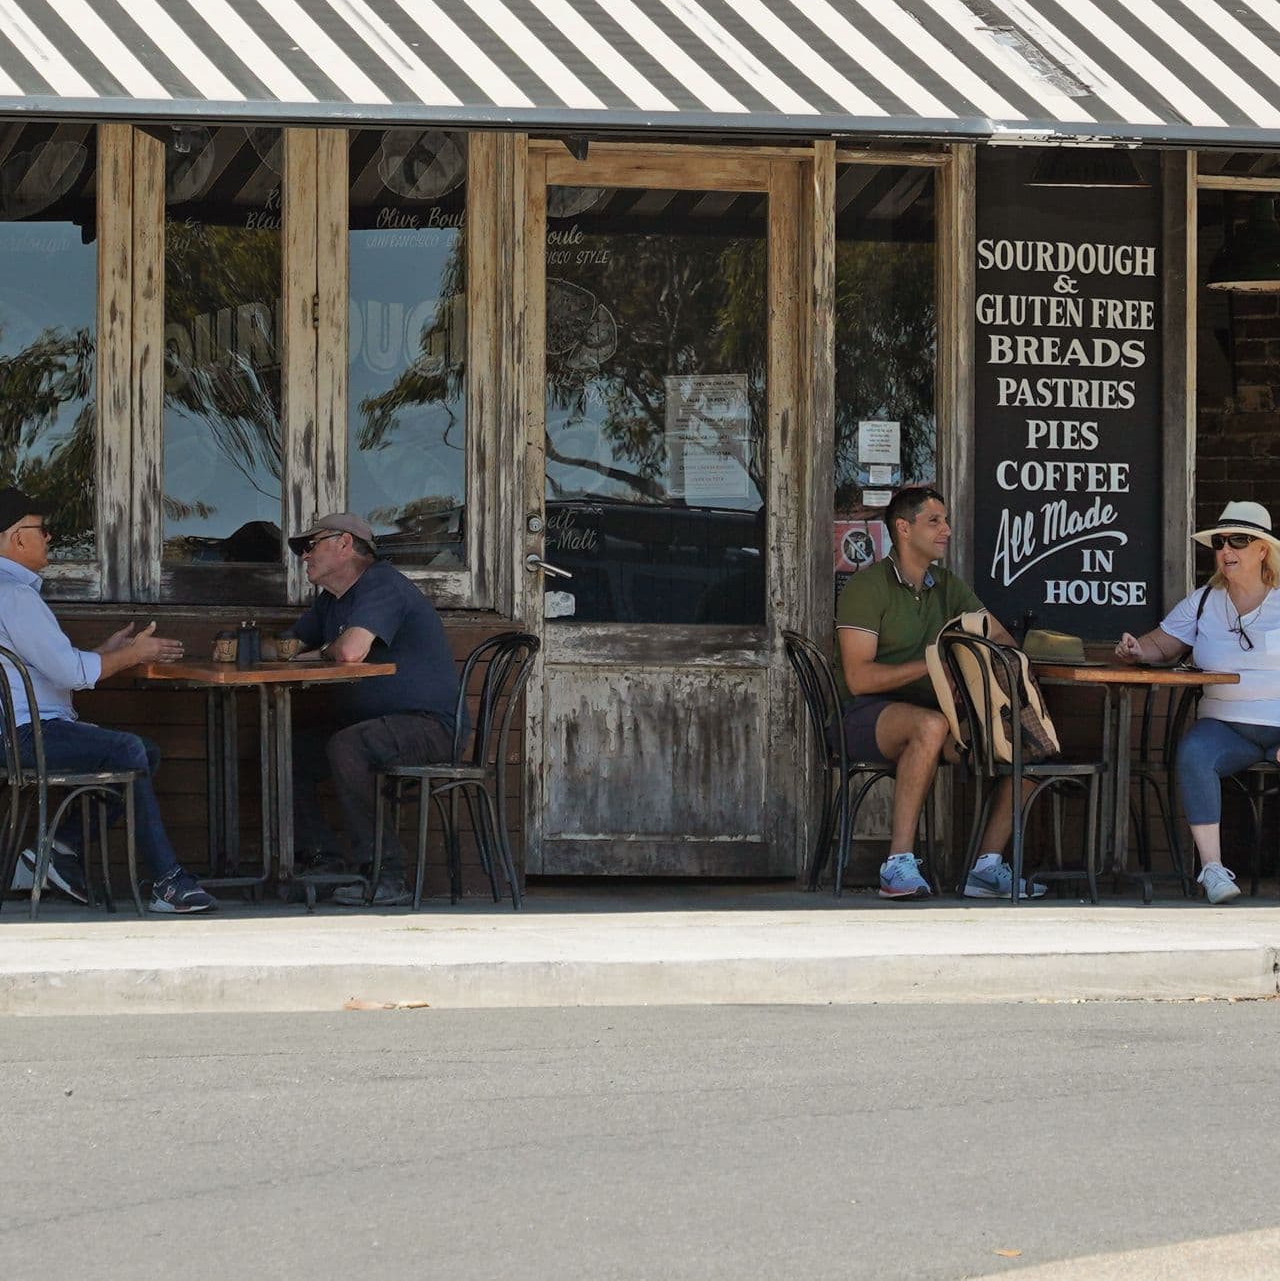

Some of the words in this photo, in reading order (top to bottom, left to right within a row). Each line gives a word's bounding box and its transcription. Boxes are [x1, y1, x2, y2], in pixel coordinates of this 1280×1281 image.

[376, 206, 420, 229] Olive
[426, 206, 466, 228] Boul
[546, 223, 584, 245] oule
[576, 250, 611, 264] STYLE
[977, 238, 1156, 277] SOURDOUGH
[1053, 274, 1079, 294] &
[975, 293, 1083, 328] GLUTEN
[1090, 298, 1155, 331] FREE
[987, 334, 1146, 368] BREADS
[996, 377, 1136, 410] PASTRIES
[1025, 419, 1099, 451] PIES
[996, 460, 1130, 493] COFFEE
[557, 529, 598, 550] Malt
[990, 507, 1035, 586] All
[1041, 496, 1118, 546] Made
[1081, 549, 1115, 573] IN
[1043, 579, 1147, 607] HOUSE
